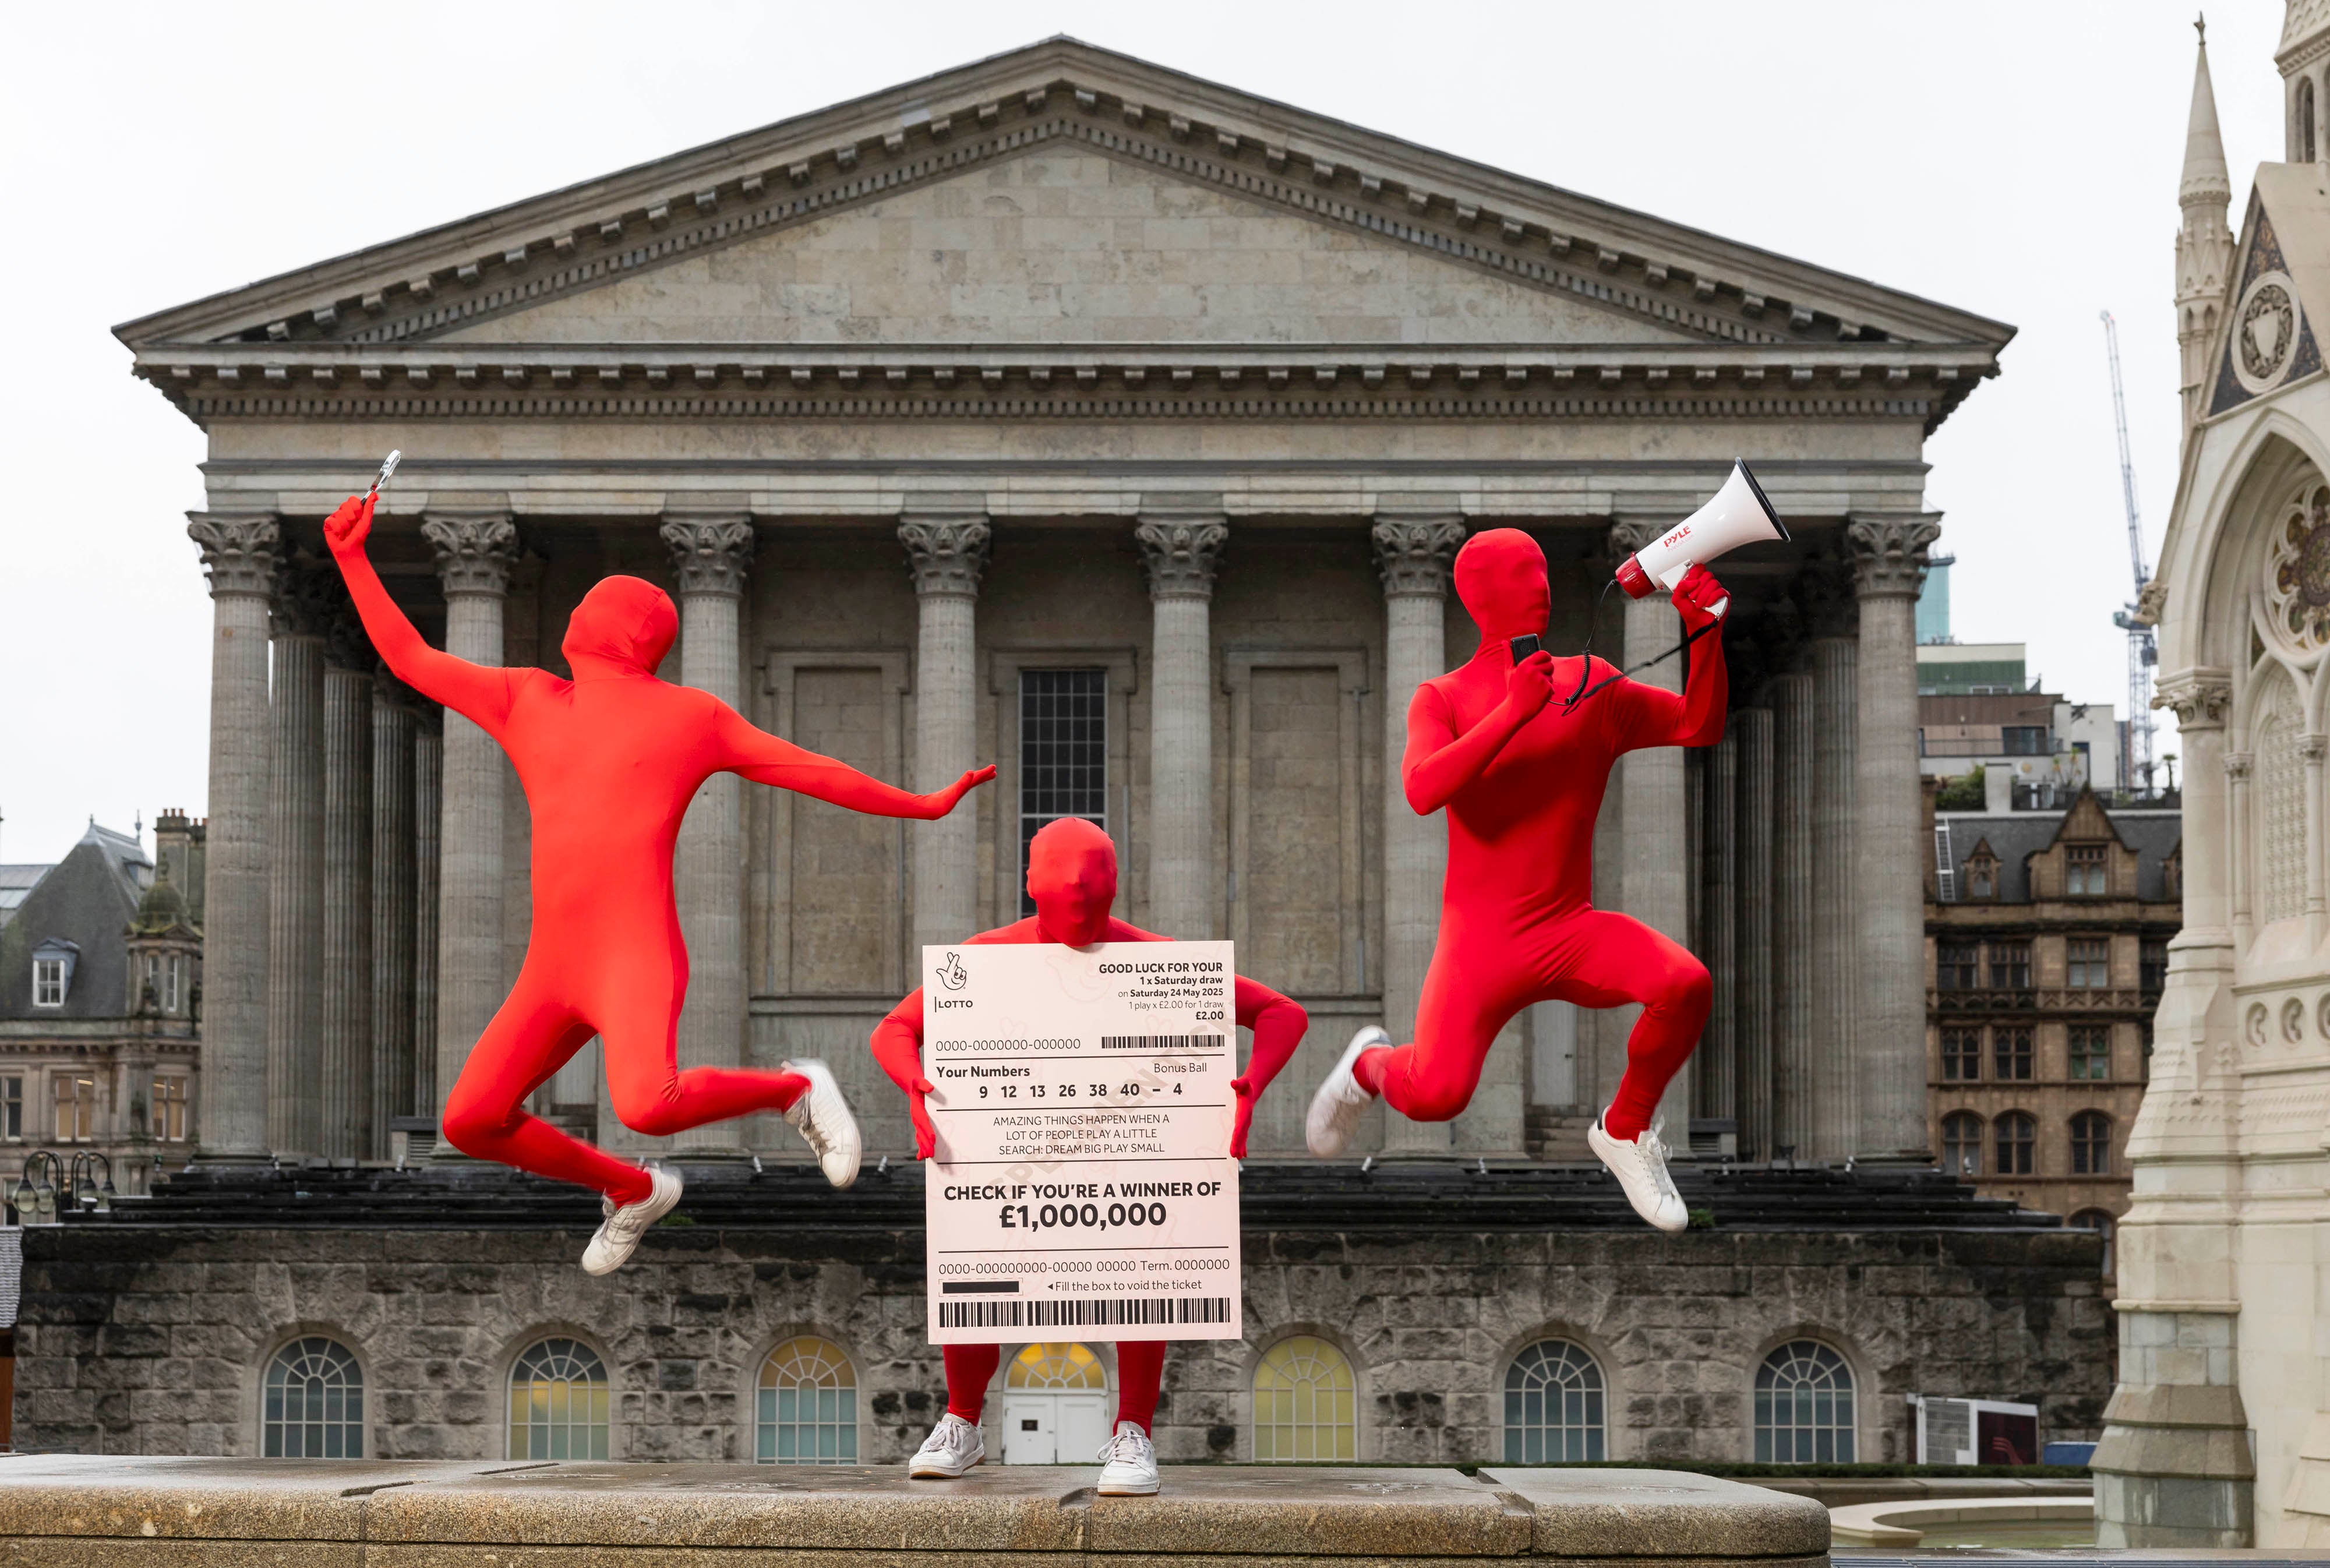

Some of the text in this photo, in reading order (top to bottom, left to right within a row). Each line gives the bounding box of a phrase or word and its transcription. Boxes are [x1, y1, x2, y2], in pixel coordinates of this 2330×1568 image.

[1664, 525, 1691, 548] PYLE
[1099, 962, 1223, 974] GOOD LUCK FOR YOUR
[1139, 976, 1145, 986] 1
[1154, 975, 1198, 987] Saturday
[1199, 975, 1224, 984] draw
[1130, 988, 1169, 999] Saturday
[1170, 988, 1182, 997] 24
[1182, 988, 1201, 998] May
[1202, 987, 1224, 997] 2025
[938, 1000, 973, 1009] LOTTO
[1128, 1001, 1132, 1009] 1
[1134, 1001, 1151, 1012] play
[1159, 1000, 1184, 1009] £2.00
[1184, 1000, 1197, 1009] for
[1198, 1000, 1202, 1008] 1
[1203, 1000, 1224, 1009] draw
[1195, 1010, 1224, 1020] £2.00
[935, 1038, 1081, 1051] 0000-0000000-000000
[935, 1065, 1030, 1078] Your Numbers
[1153, 1062, 1207, 1073] Bonus Ball
[979, 1085, 988, 1099] 9
[1000, 1085, 1017, 1099] 12
[1029, 1085, 1046, 1098] 13
[1058, 1084, 1076, 1097] 26
[1089, 1083, 1108, 1097] 38
[1120, 1083, 1140, 1096] 40
[1173, 1082, 1183, 1095] 4
[987, 1000, 1235, 1204] SPECIMEN TICK
[993, 1114, 1170, 1126] AMAZING THINGS HAPPEN WHEN A
[1006, 1128, 1157, 1140] LOT OF PEOPLE PLAY A LITTLE
[998, 1143, 1166, 1155] SEARCH: DREAM BIG PLAY SMALL
[944, 1185, 1008, 1201] CHECK
[1011, 1185, 1028, 1200] IF
[1102, 1183, 1117, 1198] A
[1120, 1182, 1194, 1198] WINNER
[1196, 1181, 1222, 1196] OF
[998, 1202, 1167, 1232] £1,000,000
[938, 1259, 1230, 1275] 0000-000000000-00000 00000 Term. 0000000
[1055, 1279, 1202, 1291] Fill the box to void the ticket
